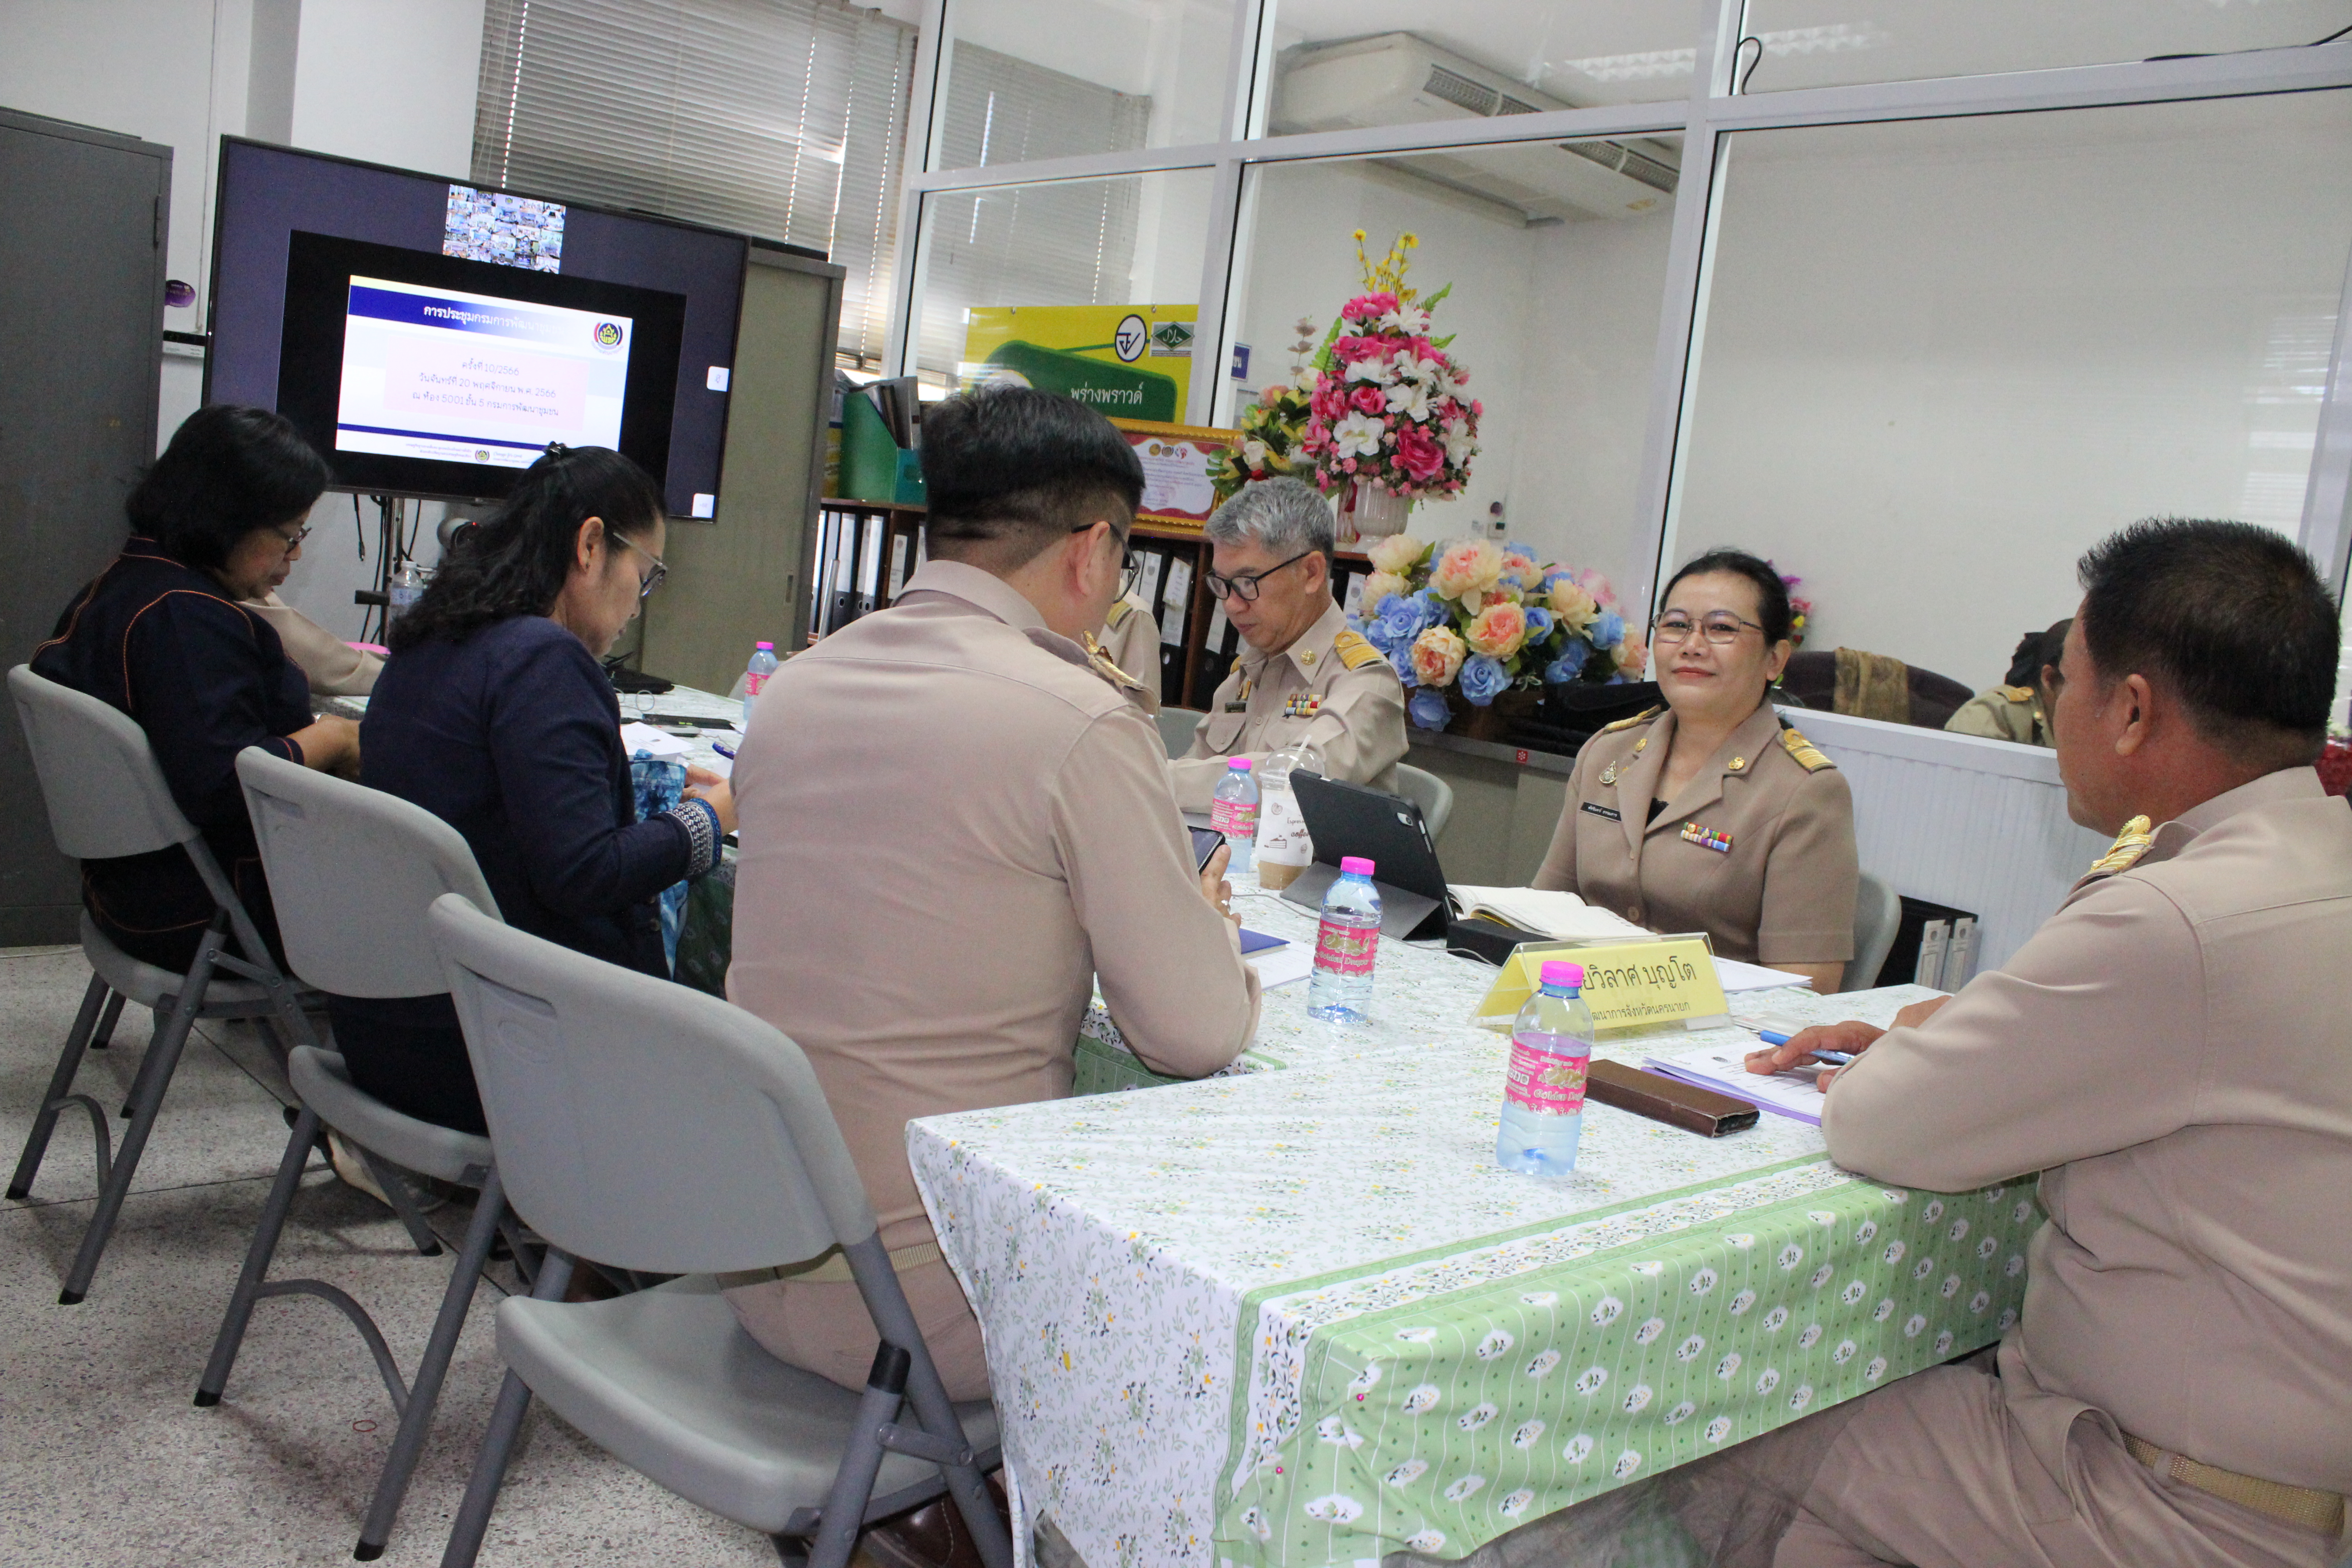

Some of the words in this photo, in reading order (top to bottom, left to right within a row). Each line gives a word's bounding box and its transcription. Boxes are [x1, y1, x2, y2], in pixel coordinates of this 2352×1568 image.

[462, 358, 483, 370] ครั้งที่
[485, 363, 519, 376] 10/2566
[419, 372, 457, 386] วันจันทร์ที่
[459, 378, 470, 387] 20
[473, 381, 516, 393] พฤศจิกายน
[535, 387, 556, 398] 2566
[1070, 381, 1144, 405] พร่างพราวด์
[412, 392, 420, 400] ณ
[423, 391, 440, 402] ห้อง
[441, 394, 464, 405] 5001
[466, 393, 476, 407] ชั้น
[479, 398, 485, 407] 5
[487, 401, 559, 416] กรมการพัฒนาชุมชน
[1287, 817, 1305, 826] Espress
[1580, 965, 1642, 991] ยวิลาศ
[1642, 956, 1697, 990] บุญโต
[1592, 1002, 1690, 1021] ฒนาการจังหวัดนครนายก
[1534, 1089, 1568, 1101] Golden
